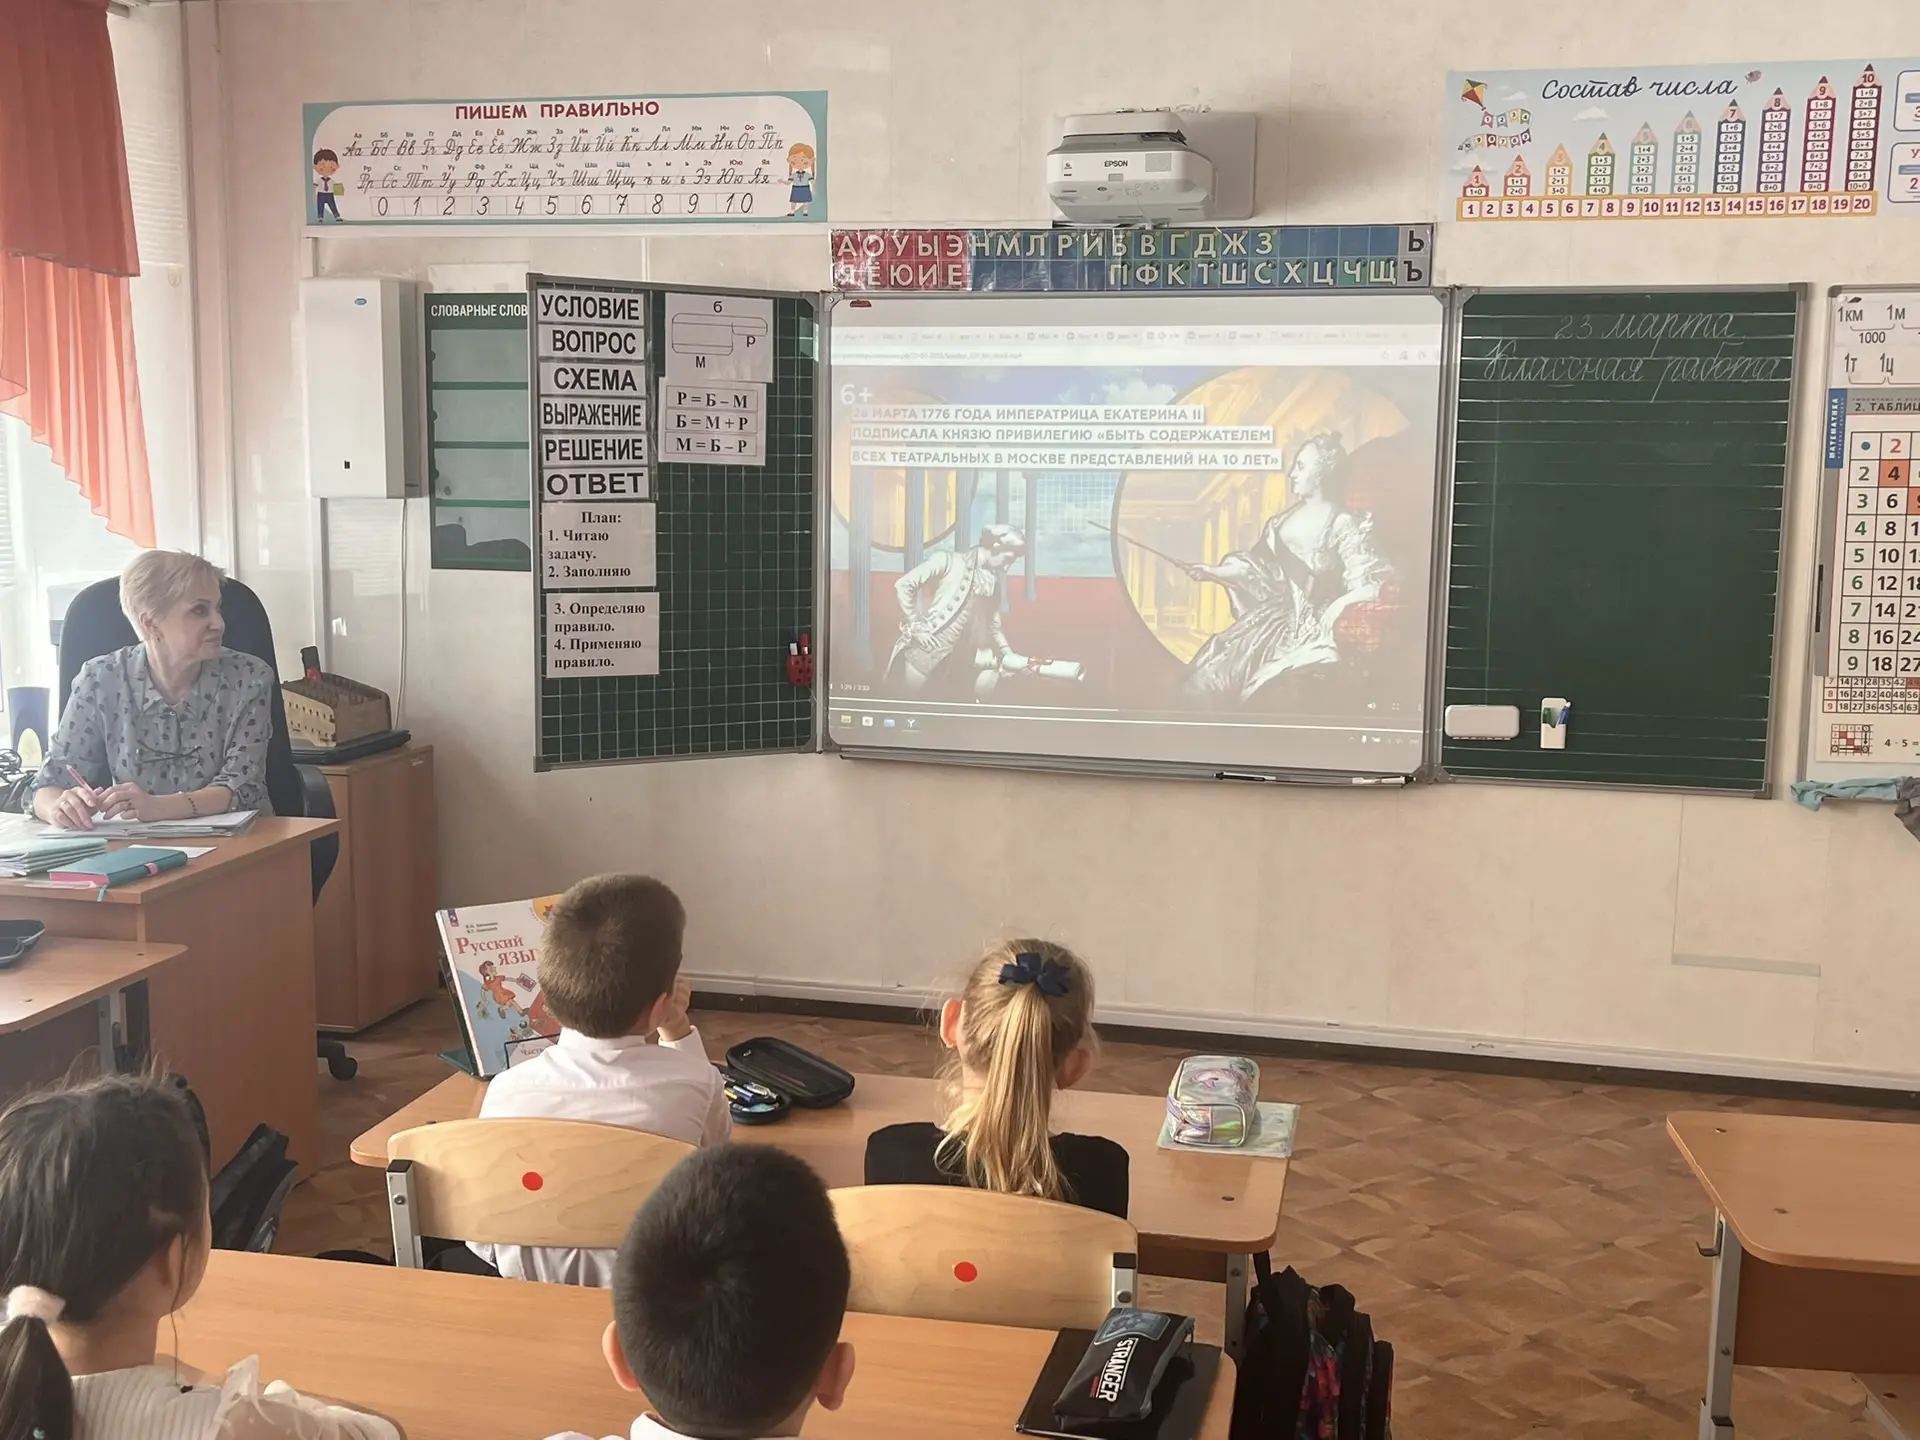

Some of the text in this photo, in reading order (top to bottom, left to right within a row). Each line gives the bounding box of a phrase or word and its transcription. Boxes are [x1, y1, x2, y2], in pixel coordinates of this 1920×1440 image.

[1542, 77, 1738, 100] Состав числа
[455, 101, 660, 120] ПИШЕМ ПРАВИЛЬНО
[1104, 160, 1129, 168] EPSON
[377, 192, 754, 216] 0 1 2 3 4 5 6 7 8 9 10
[1467, 198, 1870, 215] 1 2 3 4 5 6 7 8 9 10 11 12 13 14 15 16 17 18 19 20
[430, 303, 528, 318] СЛОВАРНЫЕ СЛОВ
[540, 294, 640, 321] УСЛОВИЕ
[552, 329, 637, 355] ВОПРОС
[1554, 312, 1736, 359] 23 марта
[1859, 331, 1886, 344] 1000
[1484, 338, 1781, 403] Классная работа
[553, 367, 638, 392] СХЕМА
[676, 391, 688, 406] Р
[705, 393, 717, 408] Б
[732, 395, 749, 409] М
[840, 383, 873, 405] 6+
[543, 402, 642, 428] ВЫРАЖЕНИЕ
[872, 408, 918, 420] МАРТА
[922, 408, 950, 420] 1776
[954, 408, 992, 421] ГОДА
[996, 408, 1100, 421] ИМПЕРАТРИЦА
[1103, 408, 1188, 421] ЕКАТЕРИНА
[675, 414, 688, 429] Б
[705, 415, 721, 430] М
[724, 418, 735, 429] +
[737, 417, 749, 432] Р
[852, 427, 1271, 442] ПОДПИСАЛА КНЯЗЮ ПРИВИЛЕГИЮ «БЫТЬ СОДЕРЖАТЕЛЕМ
[544, 438, 644, 462] РЕШЕНИЕ
[675, 437, 692, 452] М
[710, 438, 721, 453] Б
[736, 439, 748, 454] Р
[1889, 438, 1902, 454] 2
[852, 451, 1279, 467] ВСЕХ ТЕАТРАЛЬНЫХ В МОСКВЕ ПРЕДСТАВЛЕНИЙ НА 10 ЛЕТ»
[1858, 466, 1900, 481] 2 4
[545, 472, 645, 496] ОТВЕТ
[1856, 493, 1898, 509] 3 6
[580, 511, 622, 524] План:
[547, 529, 609, 542] 1. Читаю
[1854, 520, 1897, 536] 4 8
[547, 550, 597, 563] задачу.
[1853, 548, 1900, 564] 5 10
[547, 566, 631, 578] 2. Заполняю
[1851, 575, 1898, 591] 6 12
[554, 602, 645, 617] 3. Определяю
[1850, 602, 1896, 618] 7 14
[554, 622, 615, 635] правило.
[1848, 629, 1894, 645] 8 16
[554, 638, 642, 653] 4. Применяю
[554, 657, 615, 670] правило.
[1847, 656, 1893, 672] 9 18
[454, 935, 524, 956] Русский
[1099, 1338, 1134, 1402] STRANGER
